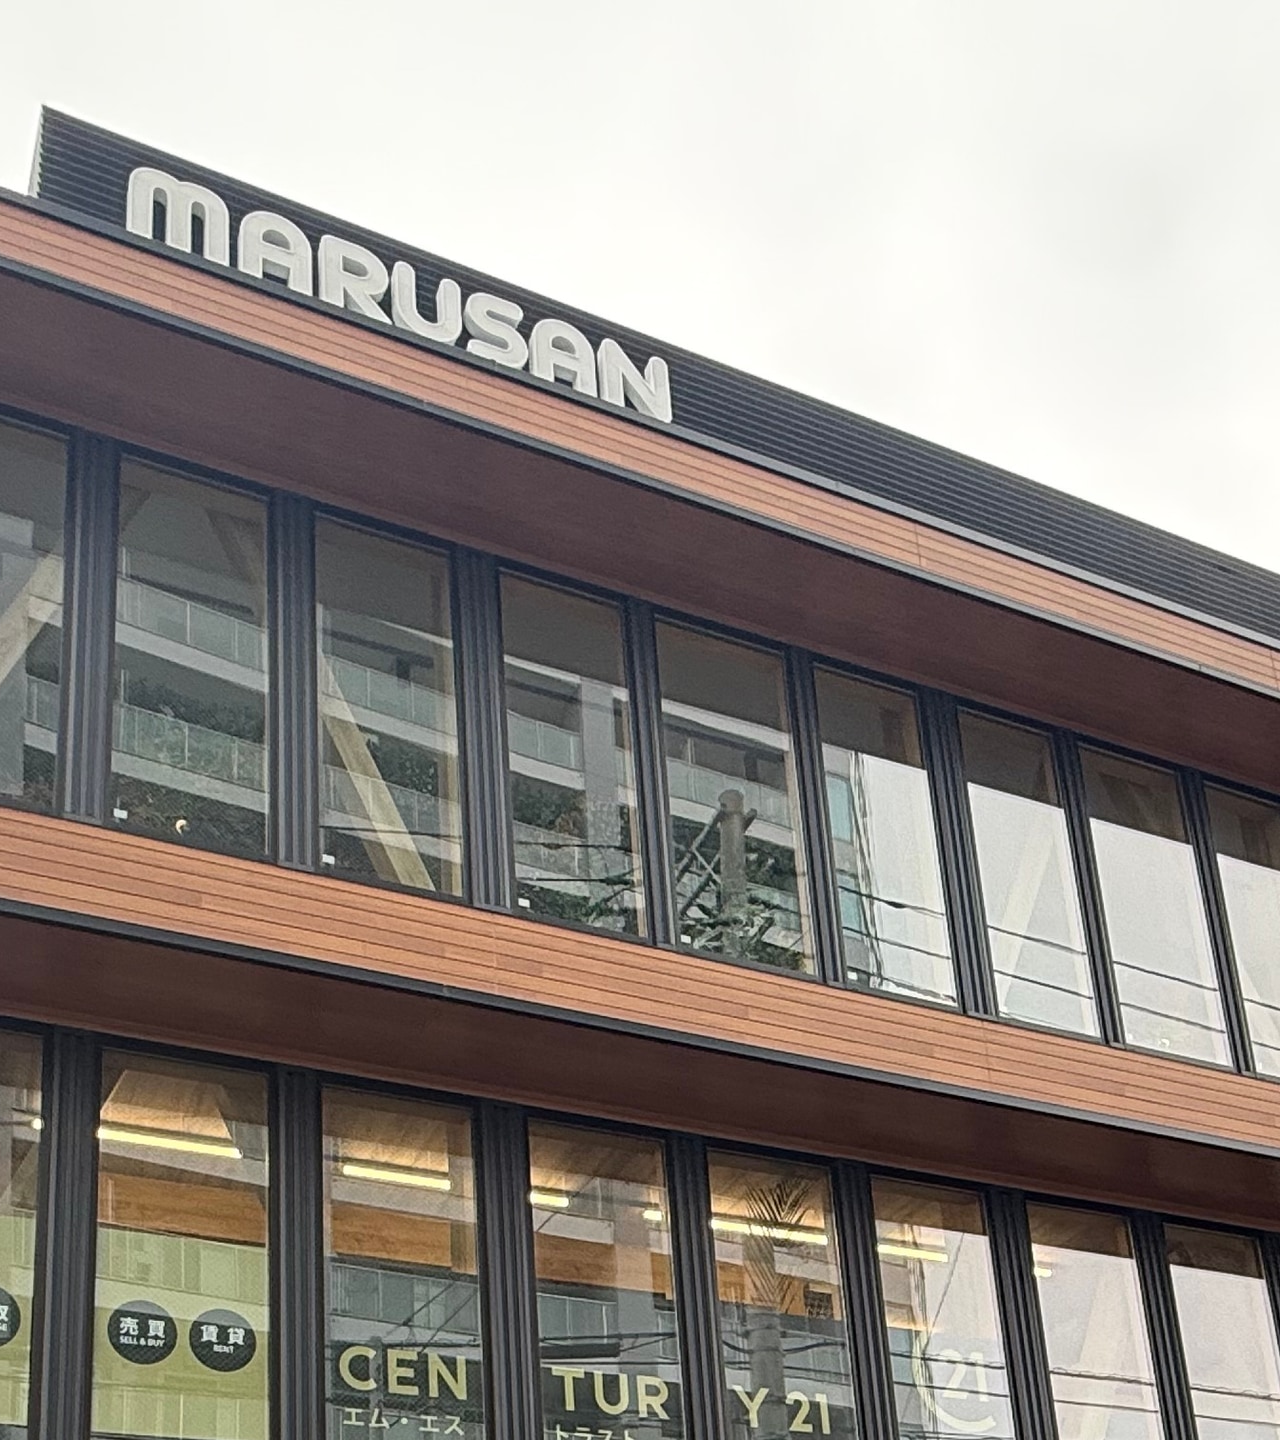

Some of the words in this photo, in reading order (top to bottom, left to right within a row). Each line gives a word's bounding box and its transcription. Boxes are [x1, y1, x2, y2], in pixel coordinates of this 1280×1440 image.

[126, 167, 672, 423] MARUSAN
[120, 1335, 137, 1345] SELL
[148, 1338, 165, 1347] BUY
[787, 1391, 831, 1434] 21
